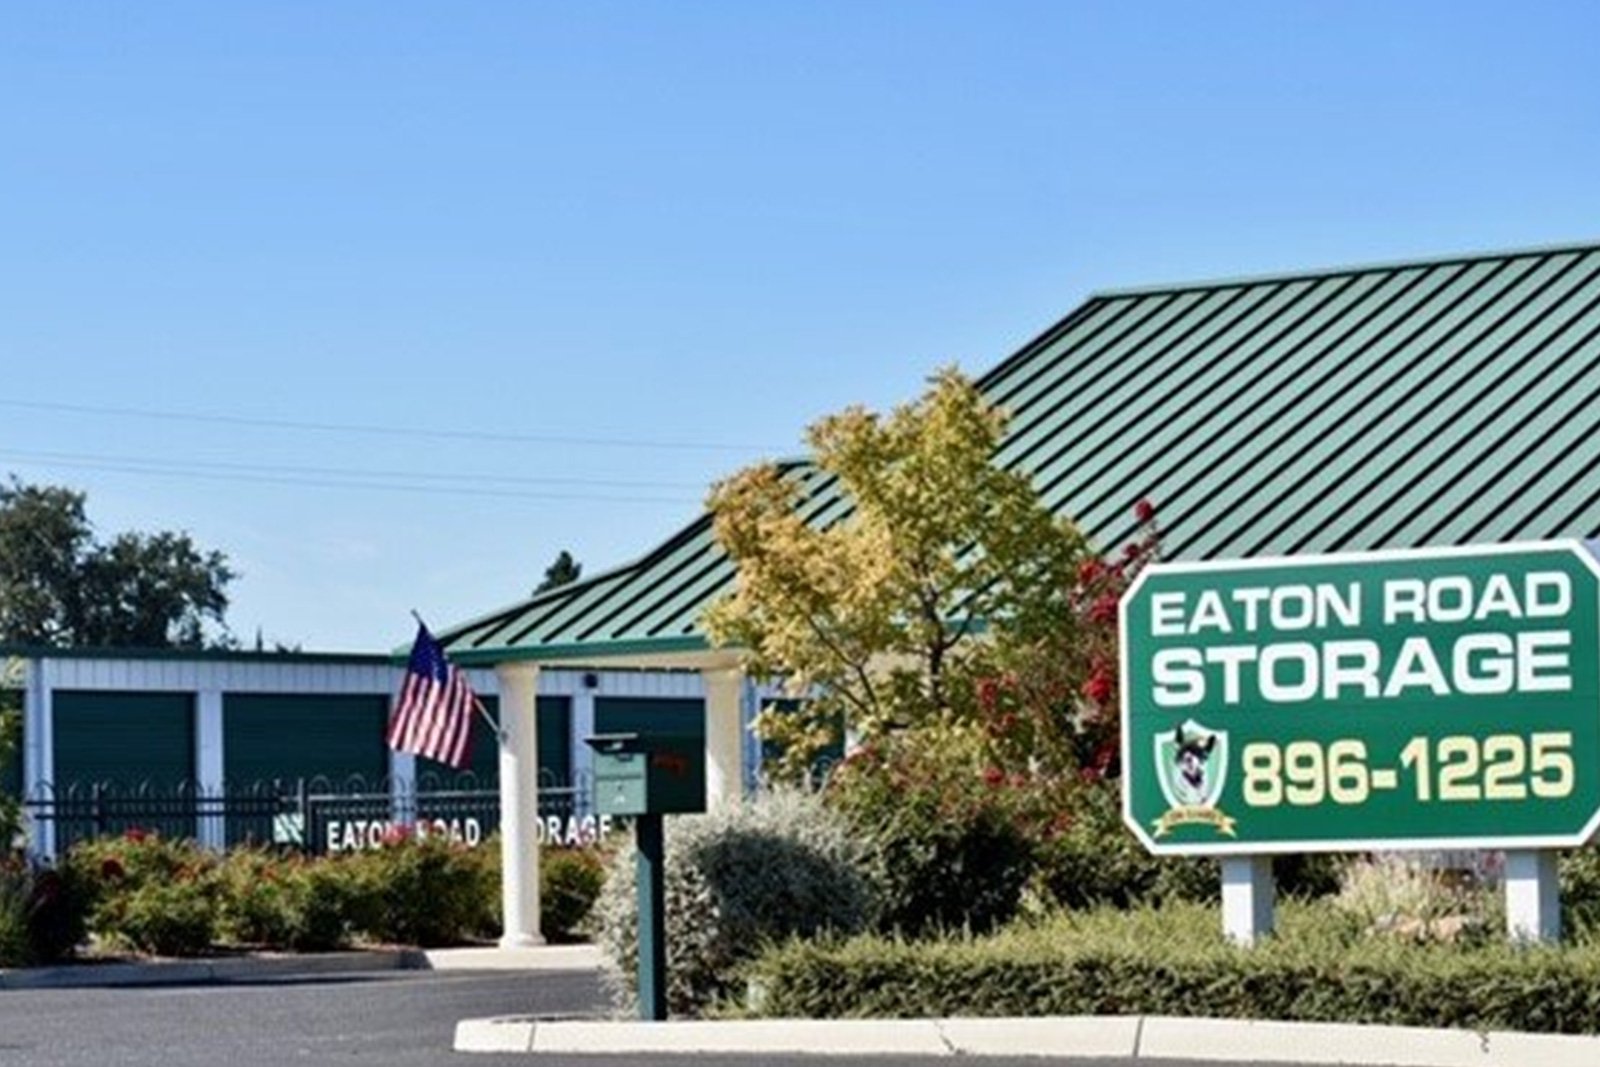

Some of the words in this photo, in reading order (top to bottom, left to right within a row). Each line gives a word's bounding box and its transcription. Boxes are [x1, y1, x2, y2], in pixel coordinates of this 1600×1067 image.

[1151, 582, 1361, 636] EATON
[1385, 572, 1572, 624] ROAD
[1152, 631, 1572, 707] STORAGE
[1242, 732, 1575, 806] 896-1225
